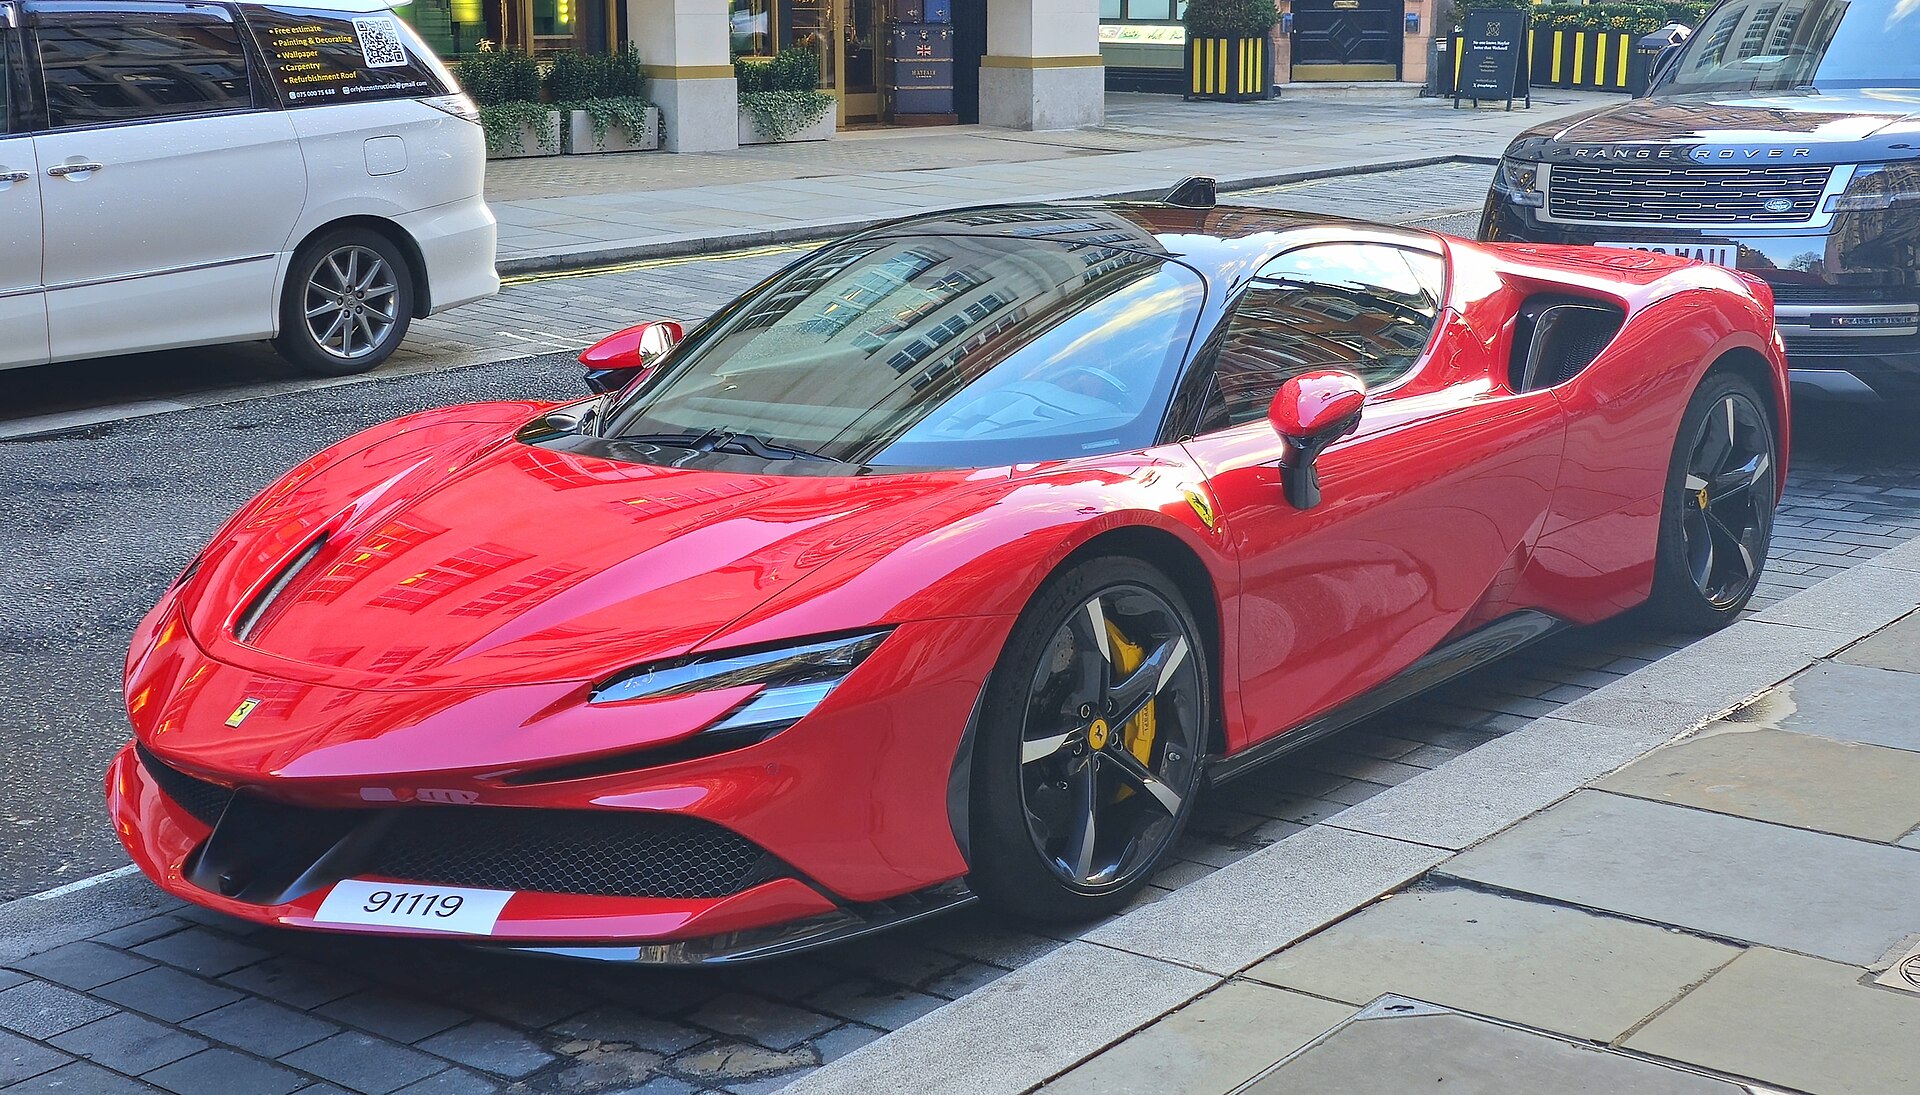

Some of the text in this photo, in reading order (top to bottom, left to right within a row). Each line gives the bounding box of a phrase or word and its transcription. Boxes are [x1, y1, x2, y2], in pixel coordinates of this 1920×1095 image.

[274, 27, 291, 35] Free
[278, 36, 352, 46] Painting & Decorating
[282, 50, 318, 59] Wallpaper
[285, 63, 320, 72] Carpentry
[289, 71, 357, 84] Refurbishment Roof
[1575, 148, 1810, 158] RANGE ROVER
[363, 891, 464, 918] 91119
